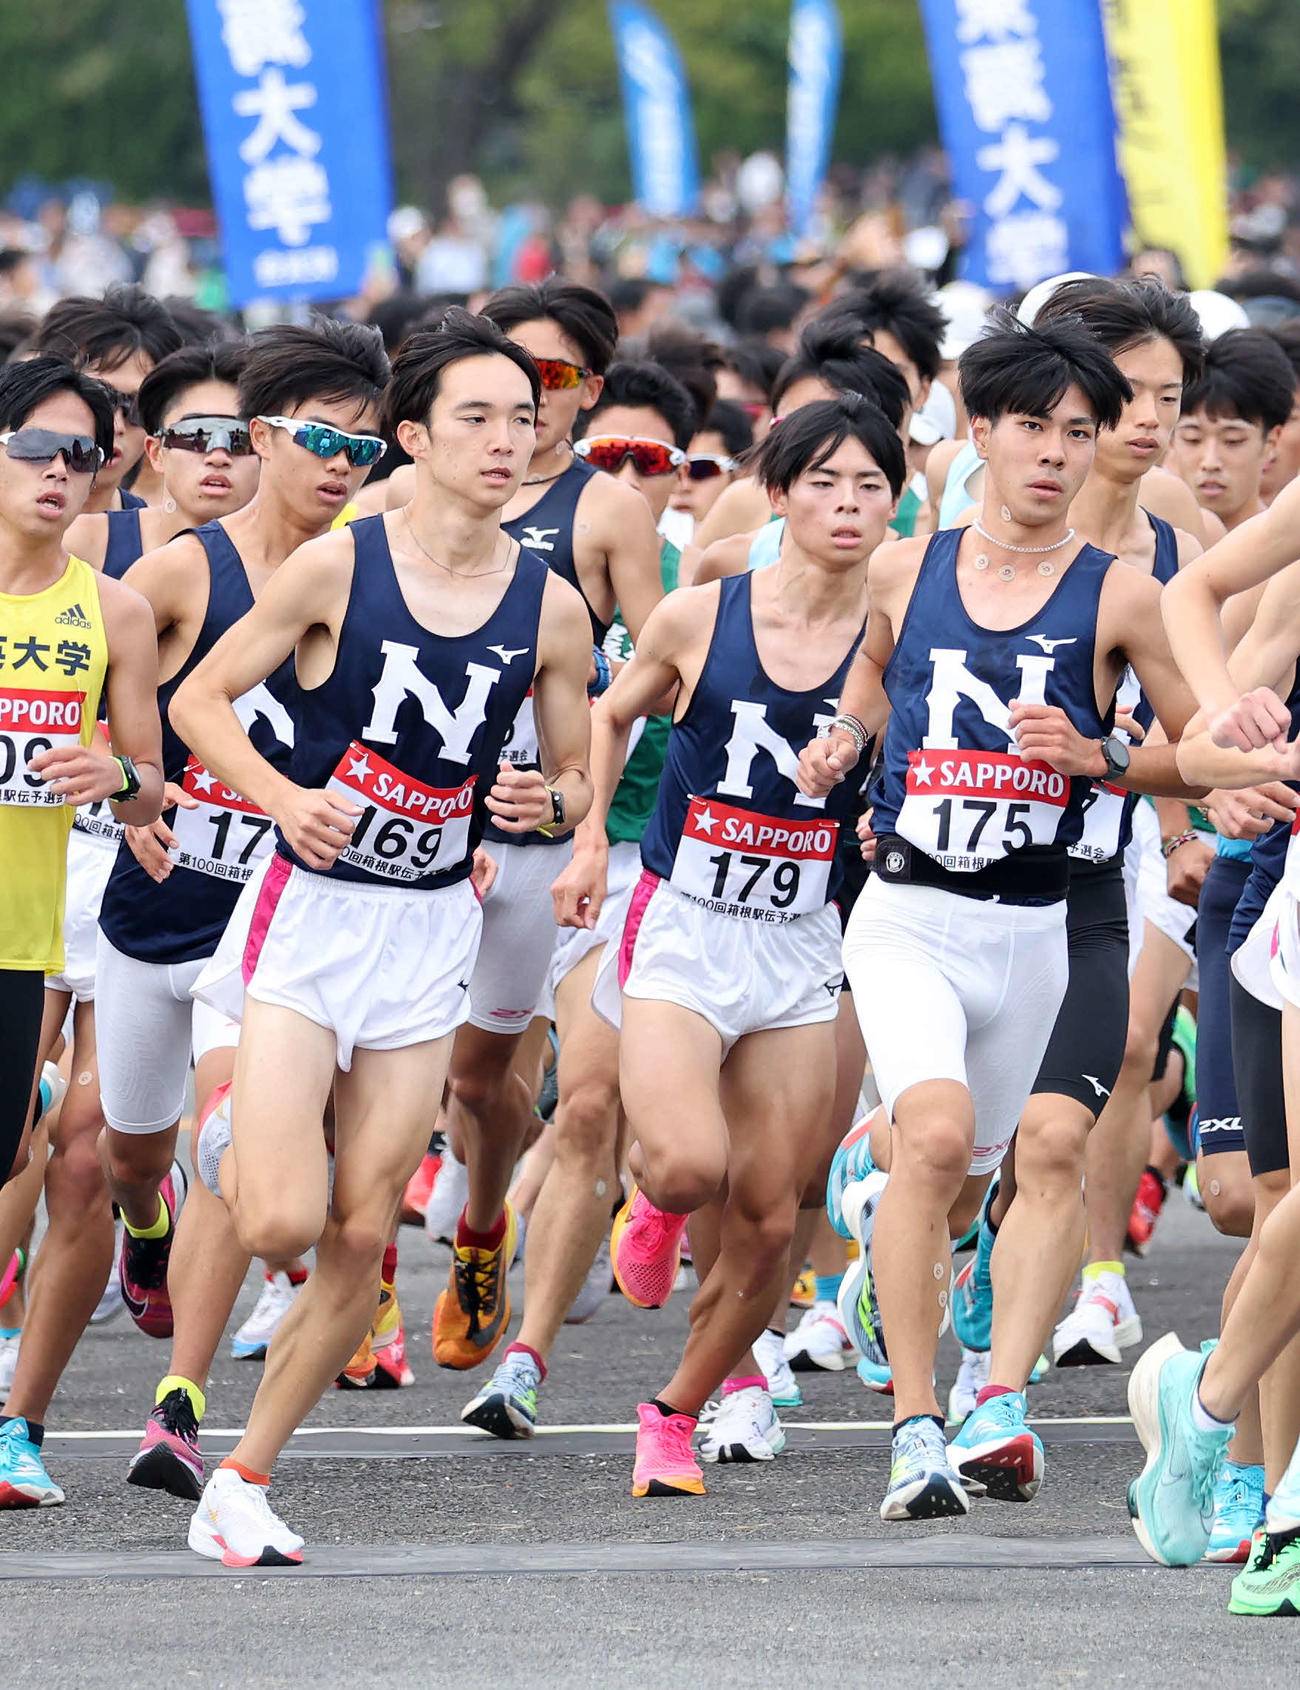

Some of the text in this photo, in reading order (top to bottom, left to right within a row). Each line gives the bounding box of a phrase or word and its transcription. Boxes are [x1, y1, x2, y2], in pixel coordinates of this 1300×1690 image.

[216, 0, 332, 247] 大学
[54, 616, 92, 629] adidas
[0, 635, 91, 676] 大学
[361, 640, 502, 766] N
[925, 648, 1055, 755] N
[716, 699, 838, 809] N
[940, 761, 1064, 798] SAPPORO
[372, 772, 473, 818] SAPPOO
[350, 804, 443, 869] 169
[721, 817, 832, 854] SAPPORO
[932, 798, 1034, 857] 175
[709, 851, 801, 909] 179
